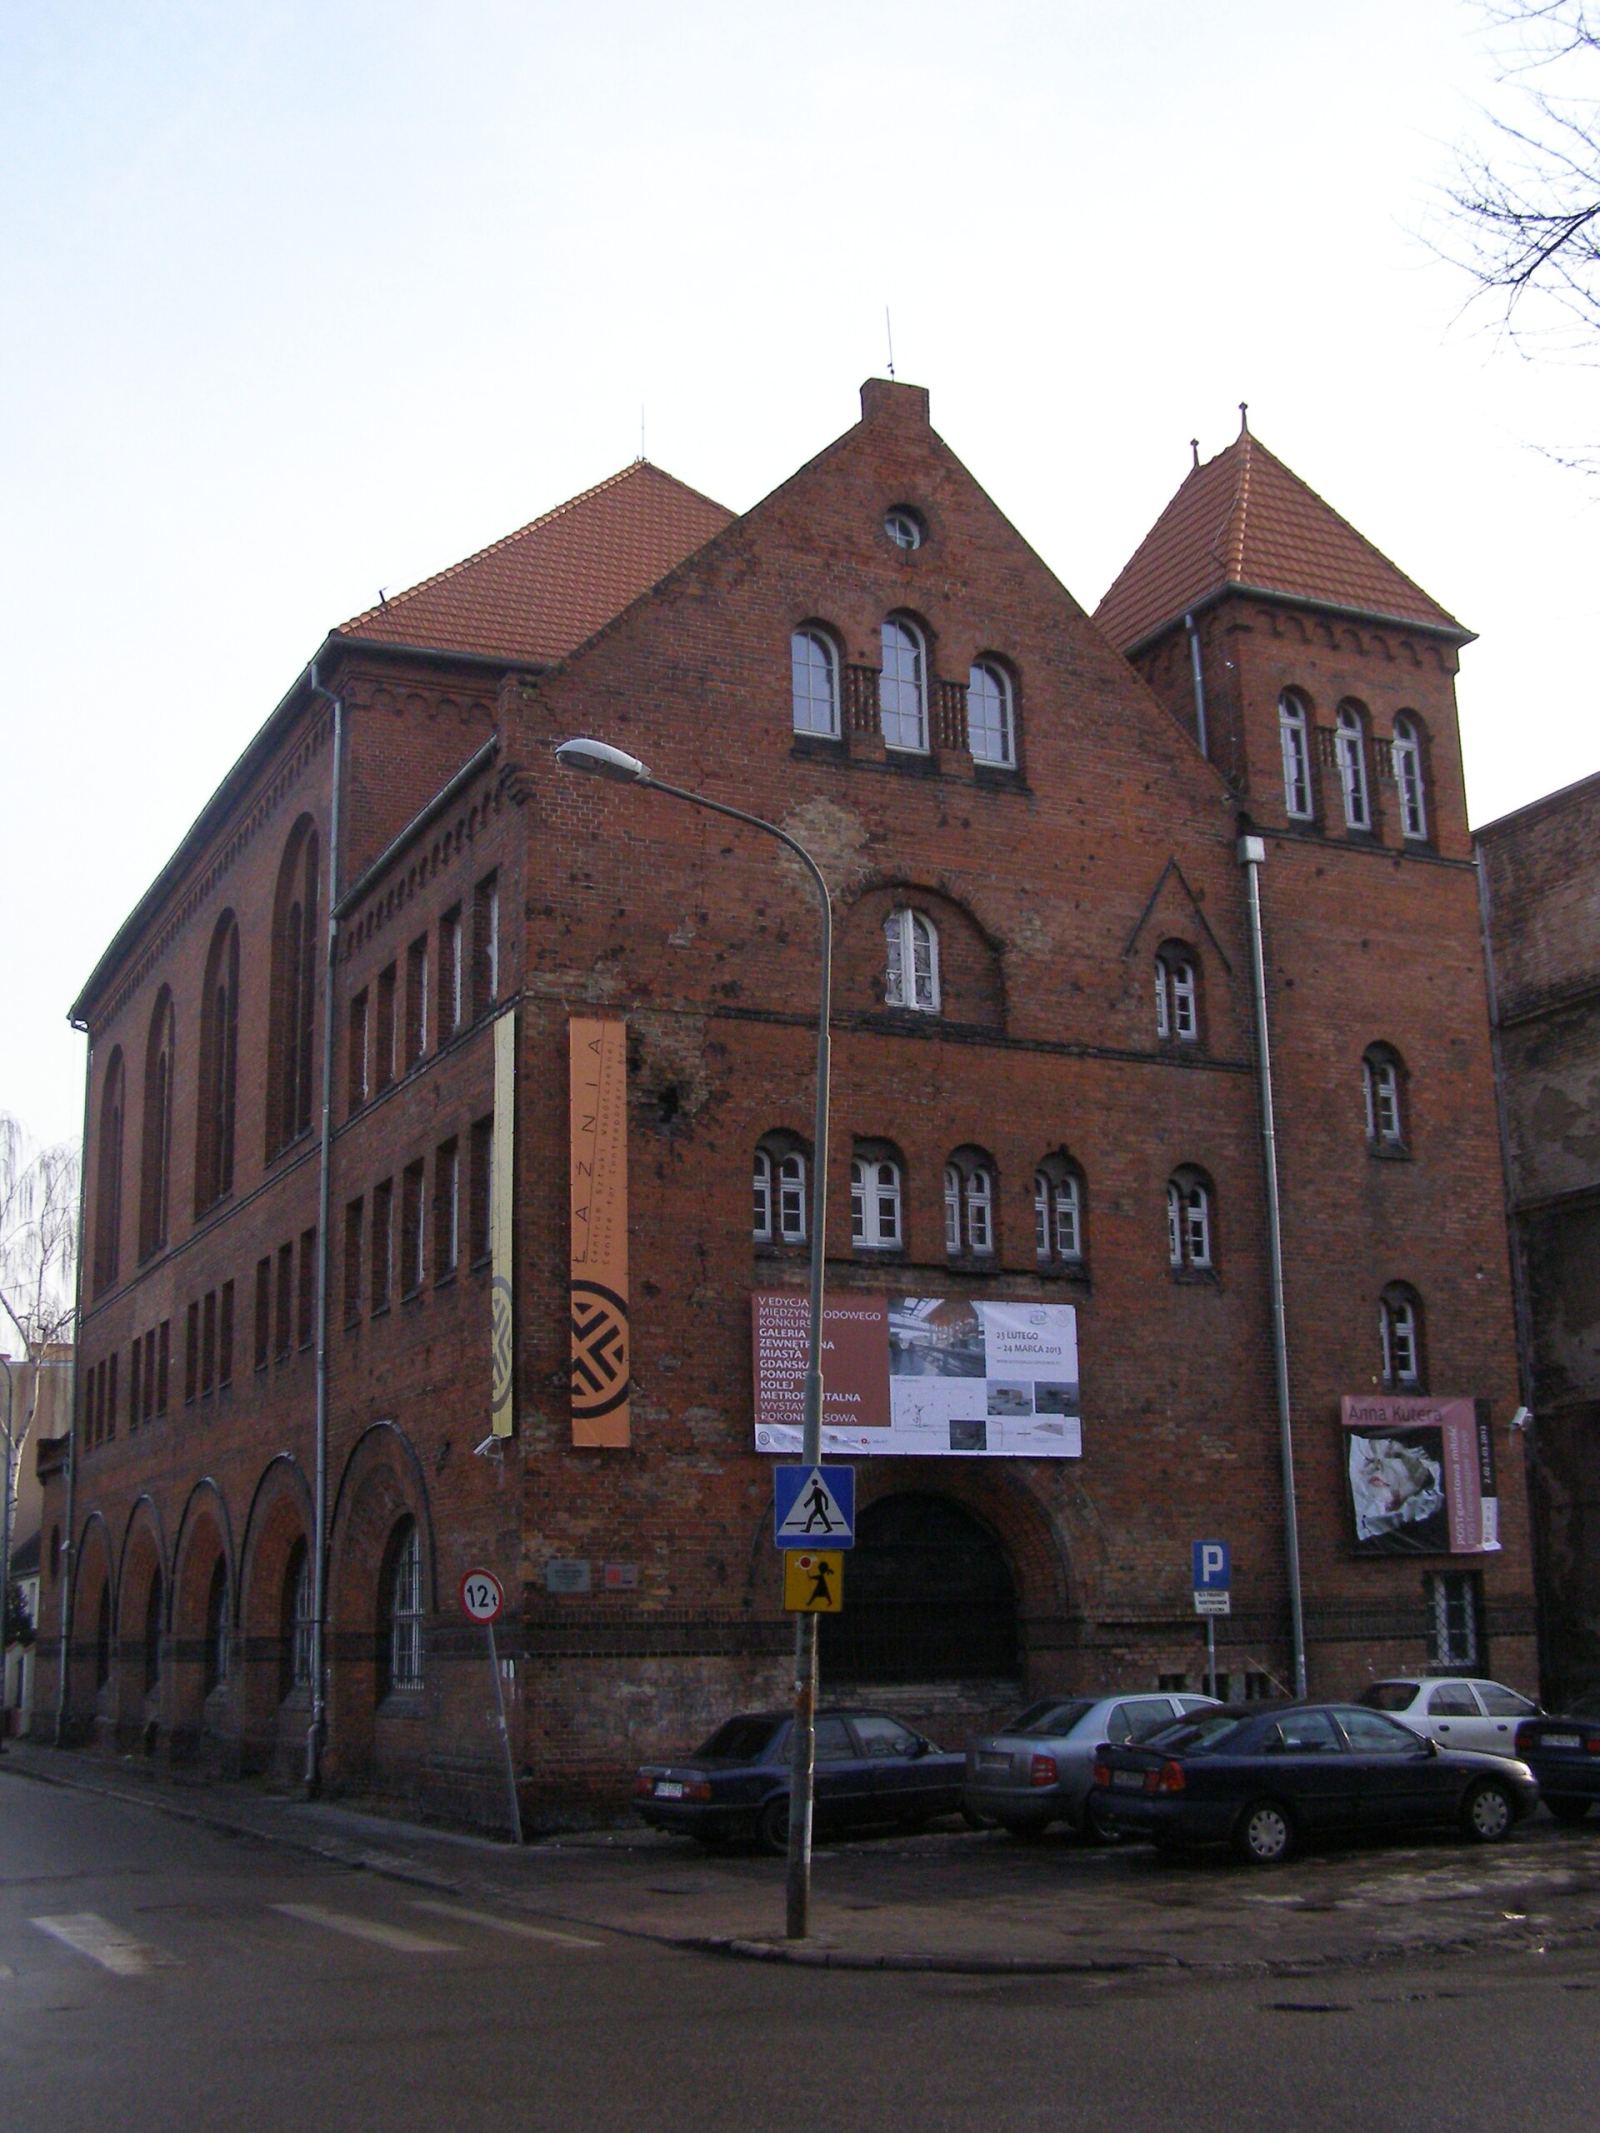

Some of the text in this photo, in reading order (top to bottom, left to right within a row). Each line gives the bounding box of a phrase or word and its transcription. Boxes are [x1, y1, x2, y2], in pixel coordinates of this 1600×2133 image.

[758, 1297, 809, 1307] V EDYCJA
[759, 1307, 881, 1321] MIĘDZYNODOWEGO
[759, 1328, 806, 1338] GALERIA
[1007, 1332, 1039, 1340] LUTEGO
[759, 1338, 835, 1351] ZEWNĘTRNA
[1015, 1345, 1044, 1353] MARCA
[759, 1349, 802, 1358] MIASTA
[760, 1381, 794, 1390] KOLEJ
[1349, 1404, 1443, 1423] Anna Kutera
[1202, 1544, 1223, 1582] P
[466, 1584, 497, 1608] 12 t
